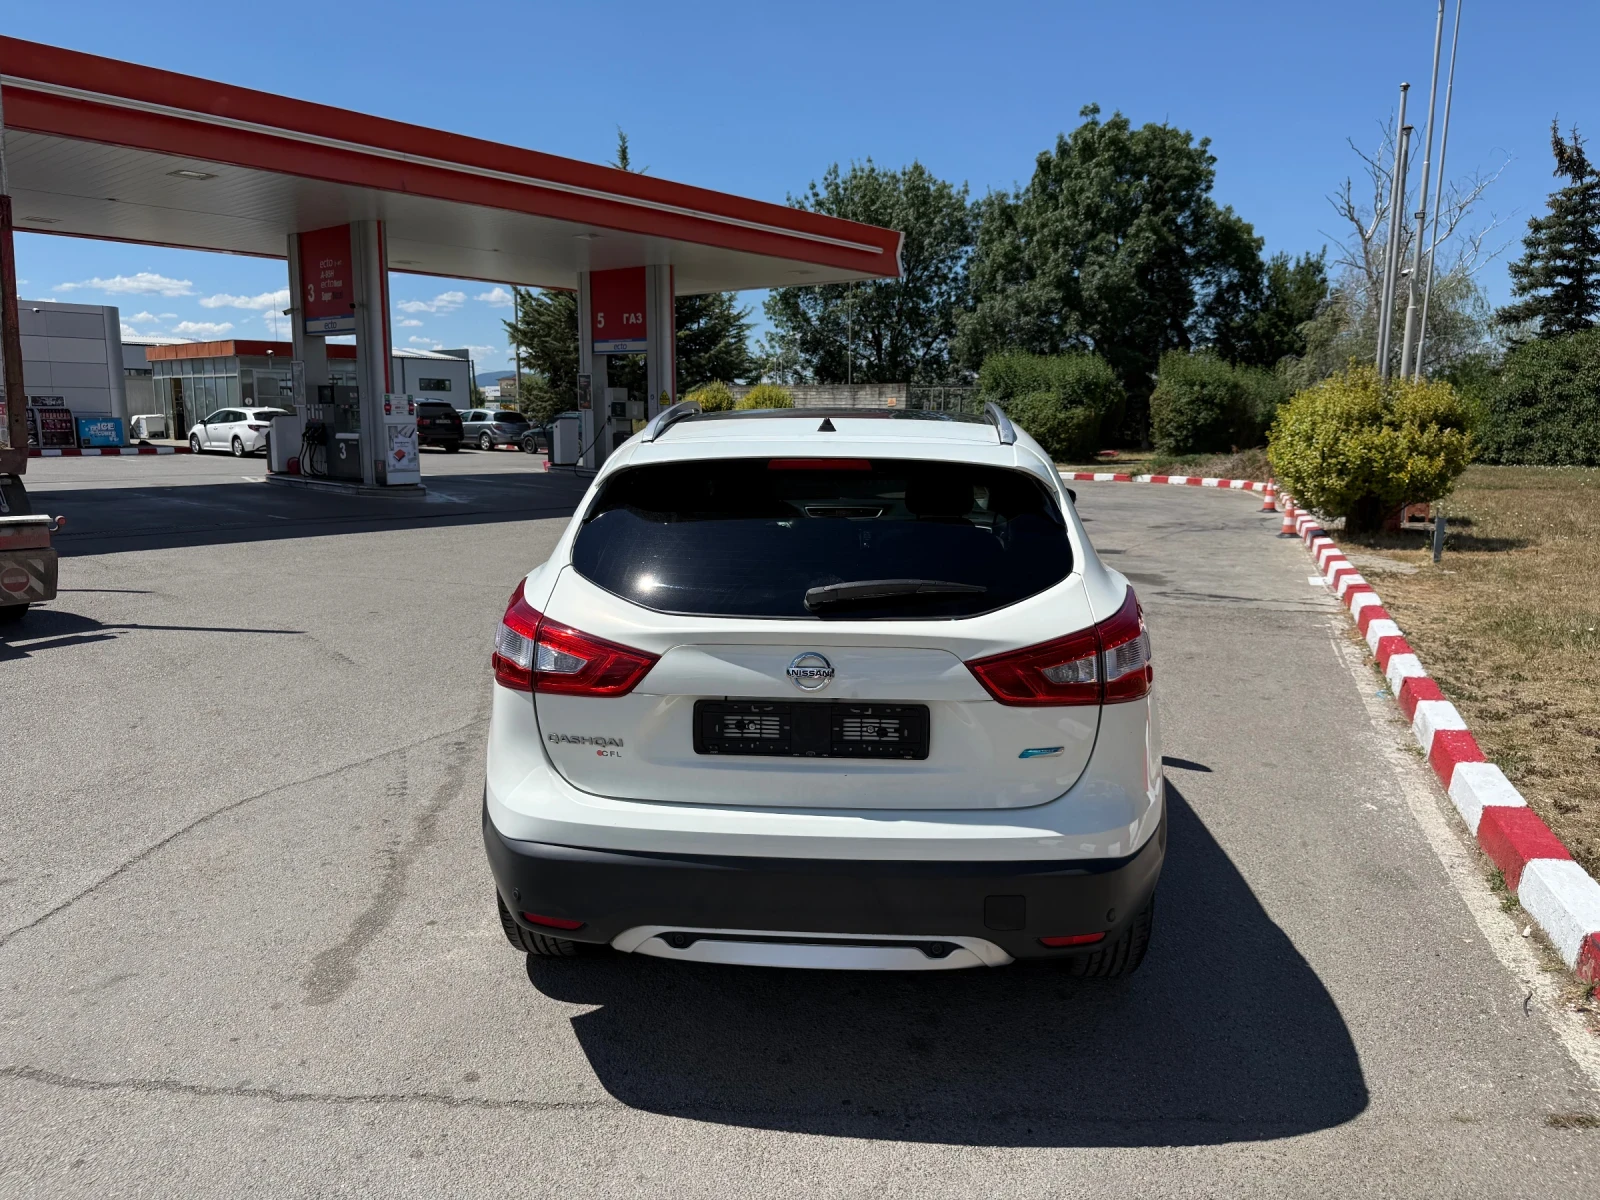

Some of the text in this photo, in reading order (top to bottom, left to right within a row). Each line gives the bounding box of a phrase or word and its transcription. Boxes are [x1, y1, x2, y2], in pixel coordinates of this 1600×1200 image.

[320, 258, 333, 268] ecto
[307, 283, 315, 302] 3
[597, 312, 605, 329] 5
[623, 312, 643, 325] ГАЗ
[324, 320, 337, 329] ecto
[613, 342, 628, 351] ecto
[97, 422, 115, 430] ICE
[339, 442, 347, 459] 3
[791, 669, 832, 678] NISSAN
[548, 732, 624, 748] QASHQAI
